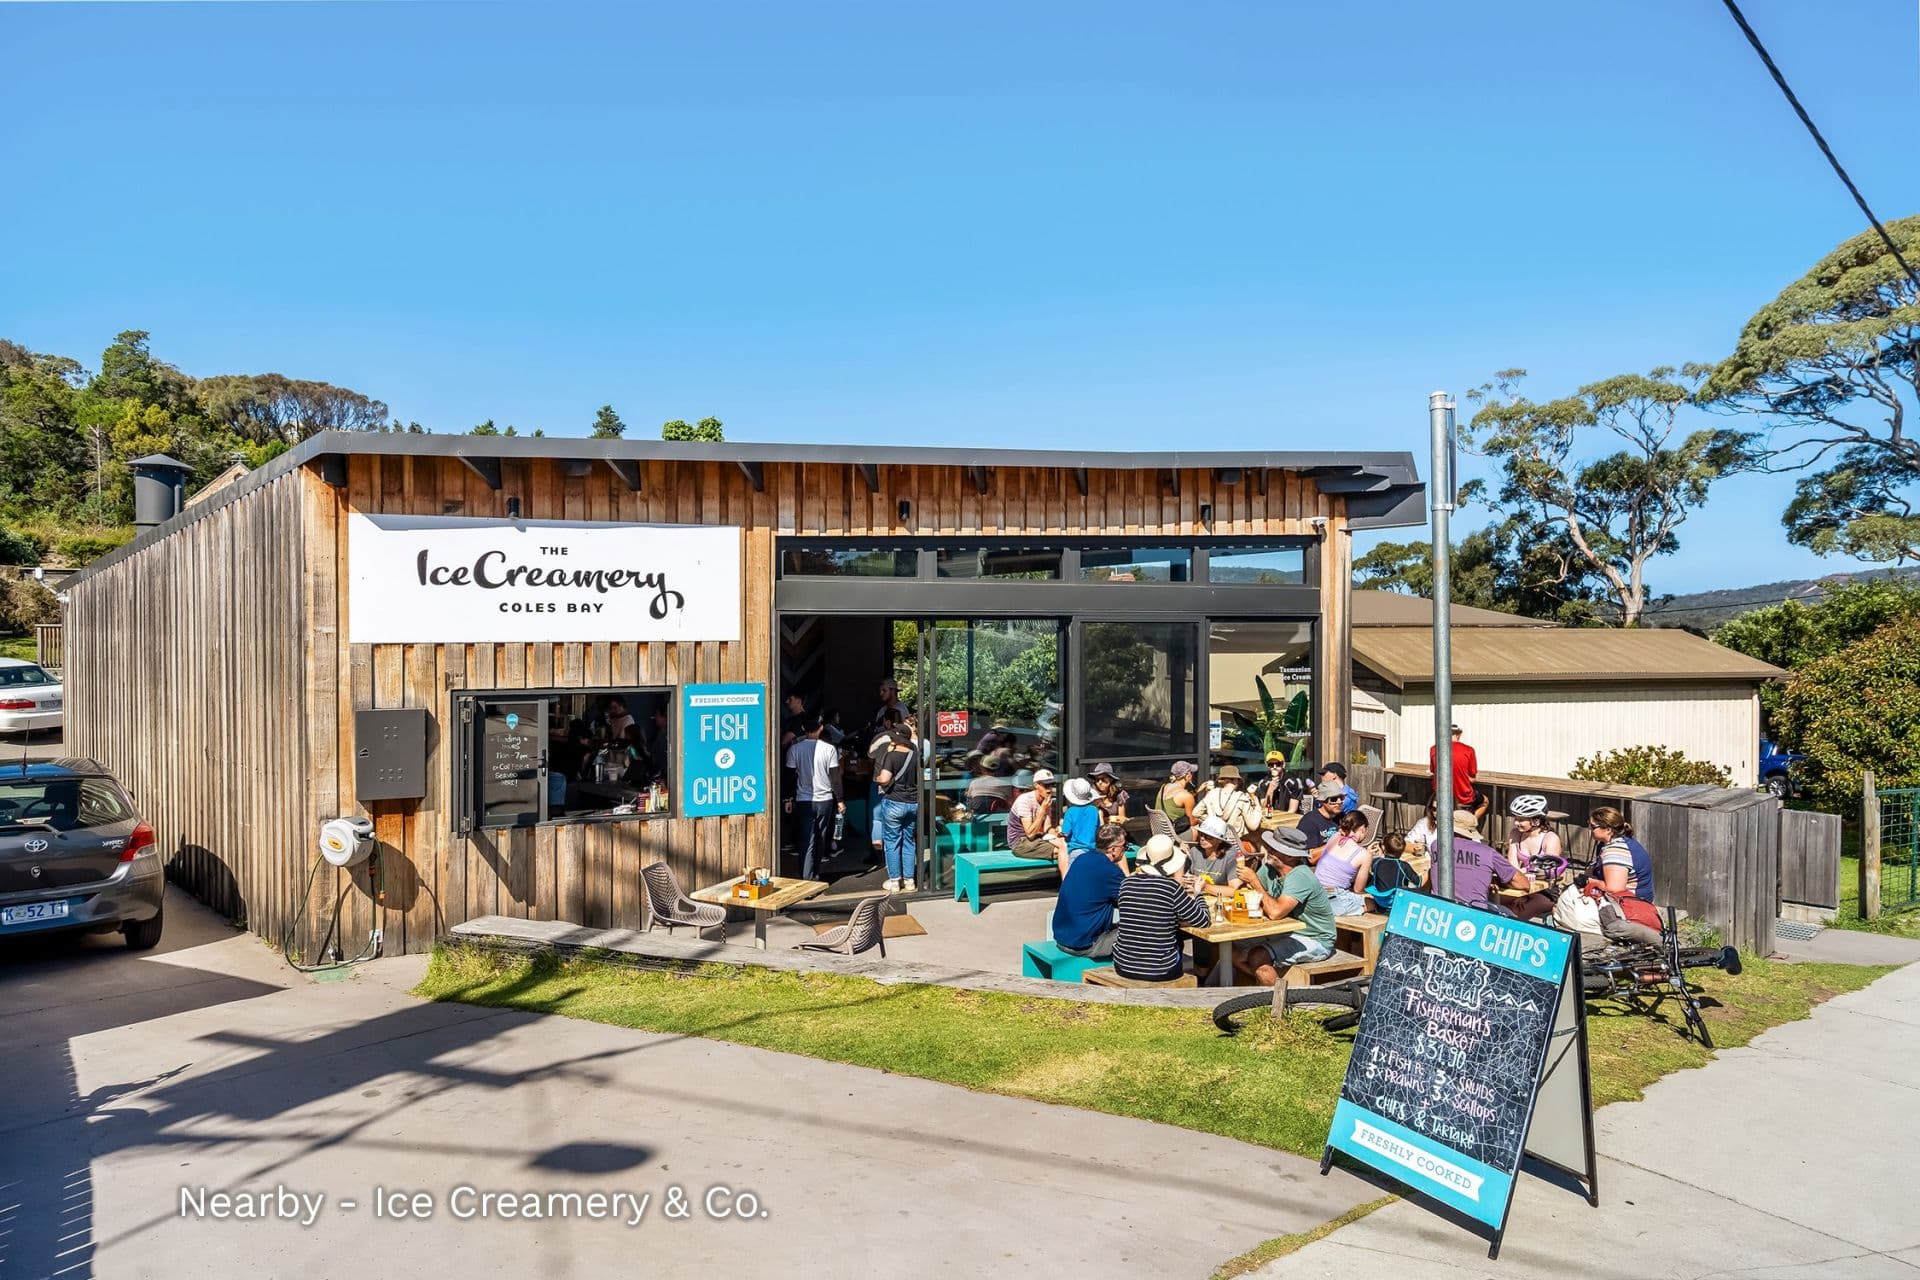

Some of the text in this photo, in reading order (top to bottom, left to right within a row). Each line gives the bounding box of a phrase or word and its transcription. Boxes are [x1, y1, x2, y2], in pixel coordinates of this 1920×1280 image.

[540, 546, 568, 555] THE
[499, 602, 604, 613] COLES BAY
[700, 713, 749, 742] FISH
[940, 723, 967, 734] OPEN
[720, 752, 731, 764] &
[693, 775, 757, 805] CHIPS
[5, 901, 66, 921] K 52 TT
[1404, 902, 1549, 967] FISH & CHIPS
[1431, 975, 1477, 1003] Special
[1415, 1033, 1467, 1069] $31.90
[1376, 1095, 1406, 1120] CHIPS
[1414, 1110, 1427, 1130] &
[1360, 1129, 1472, 1189] FRESHLY COOKED
